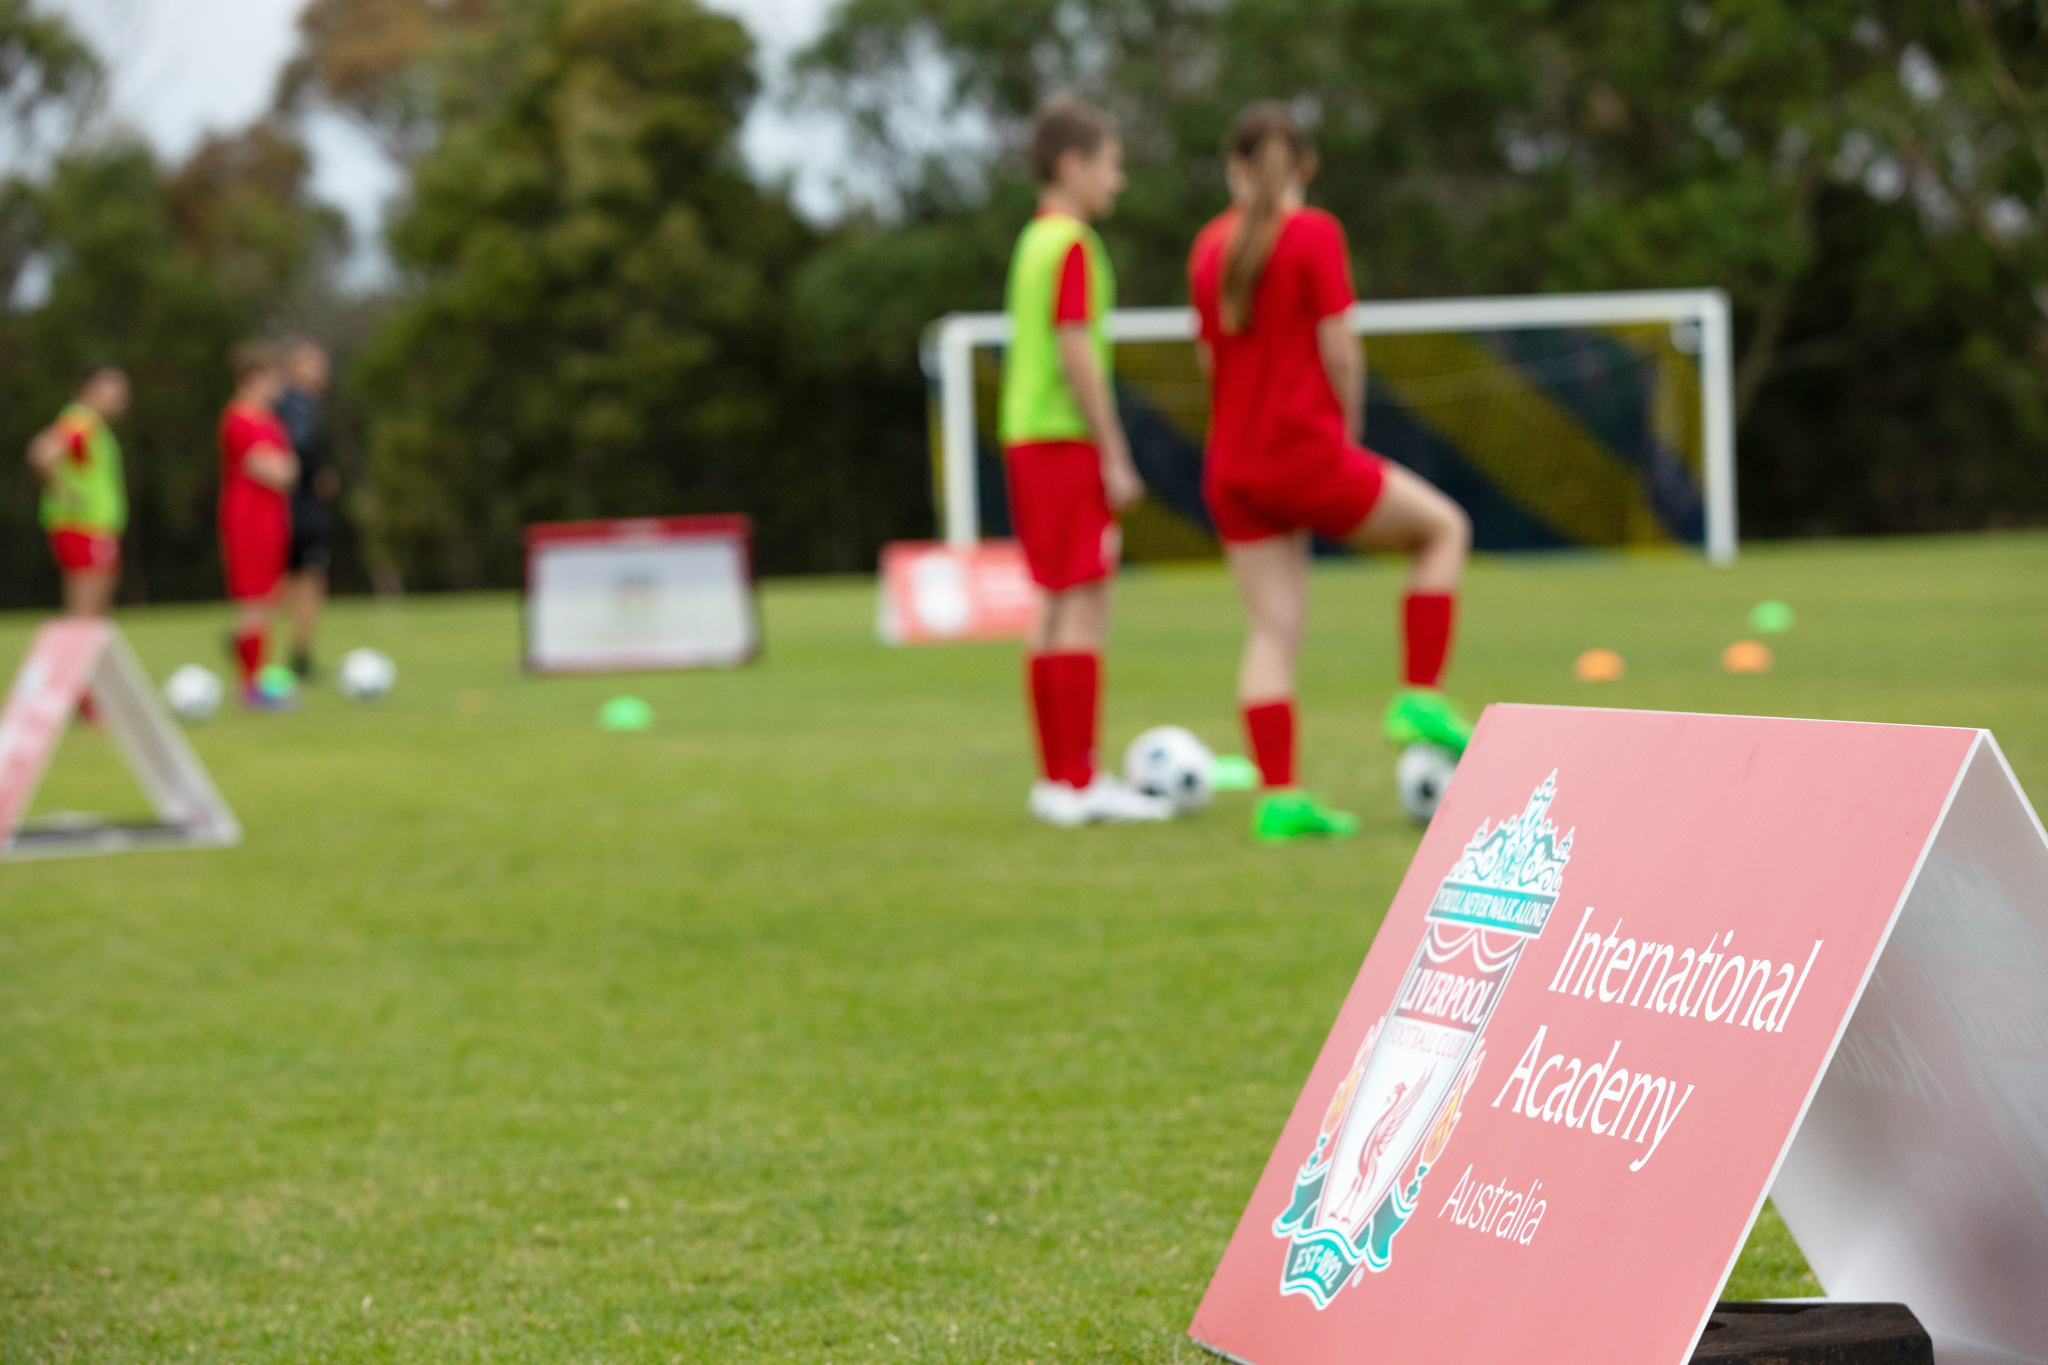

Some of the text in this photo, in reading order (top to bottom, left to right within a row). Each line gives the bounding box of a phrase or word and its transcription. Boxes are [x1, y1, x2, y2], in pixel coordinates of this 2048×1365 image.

[1460, 891, 1493, 919] NEVER
[1488, 895, 1521, 921] WALK
[1511, 900, 1550, 927] ALONE
[1399, 966, 1495, 1026] LIVERPOOL
[1548, 906, 1824, 1034] International
[1435, 1031, 1467, 1060] CLUB
[1491, 1024, 1695, 1172] Academy
[1438, 1163, 1547, 1246] Australia
